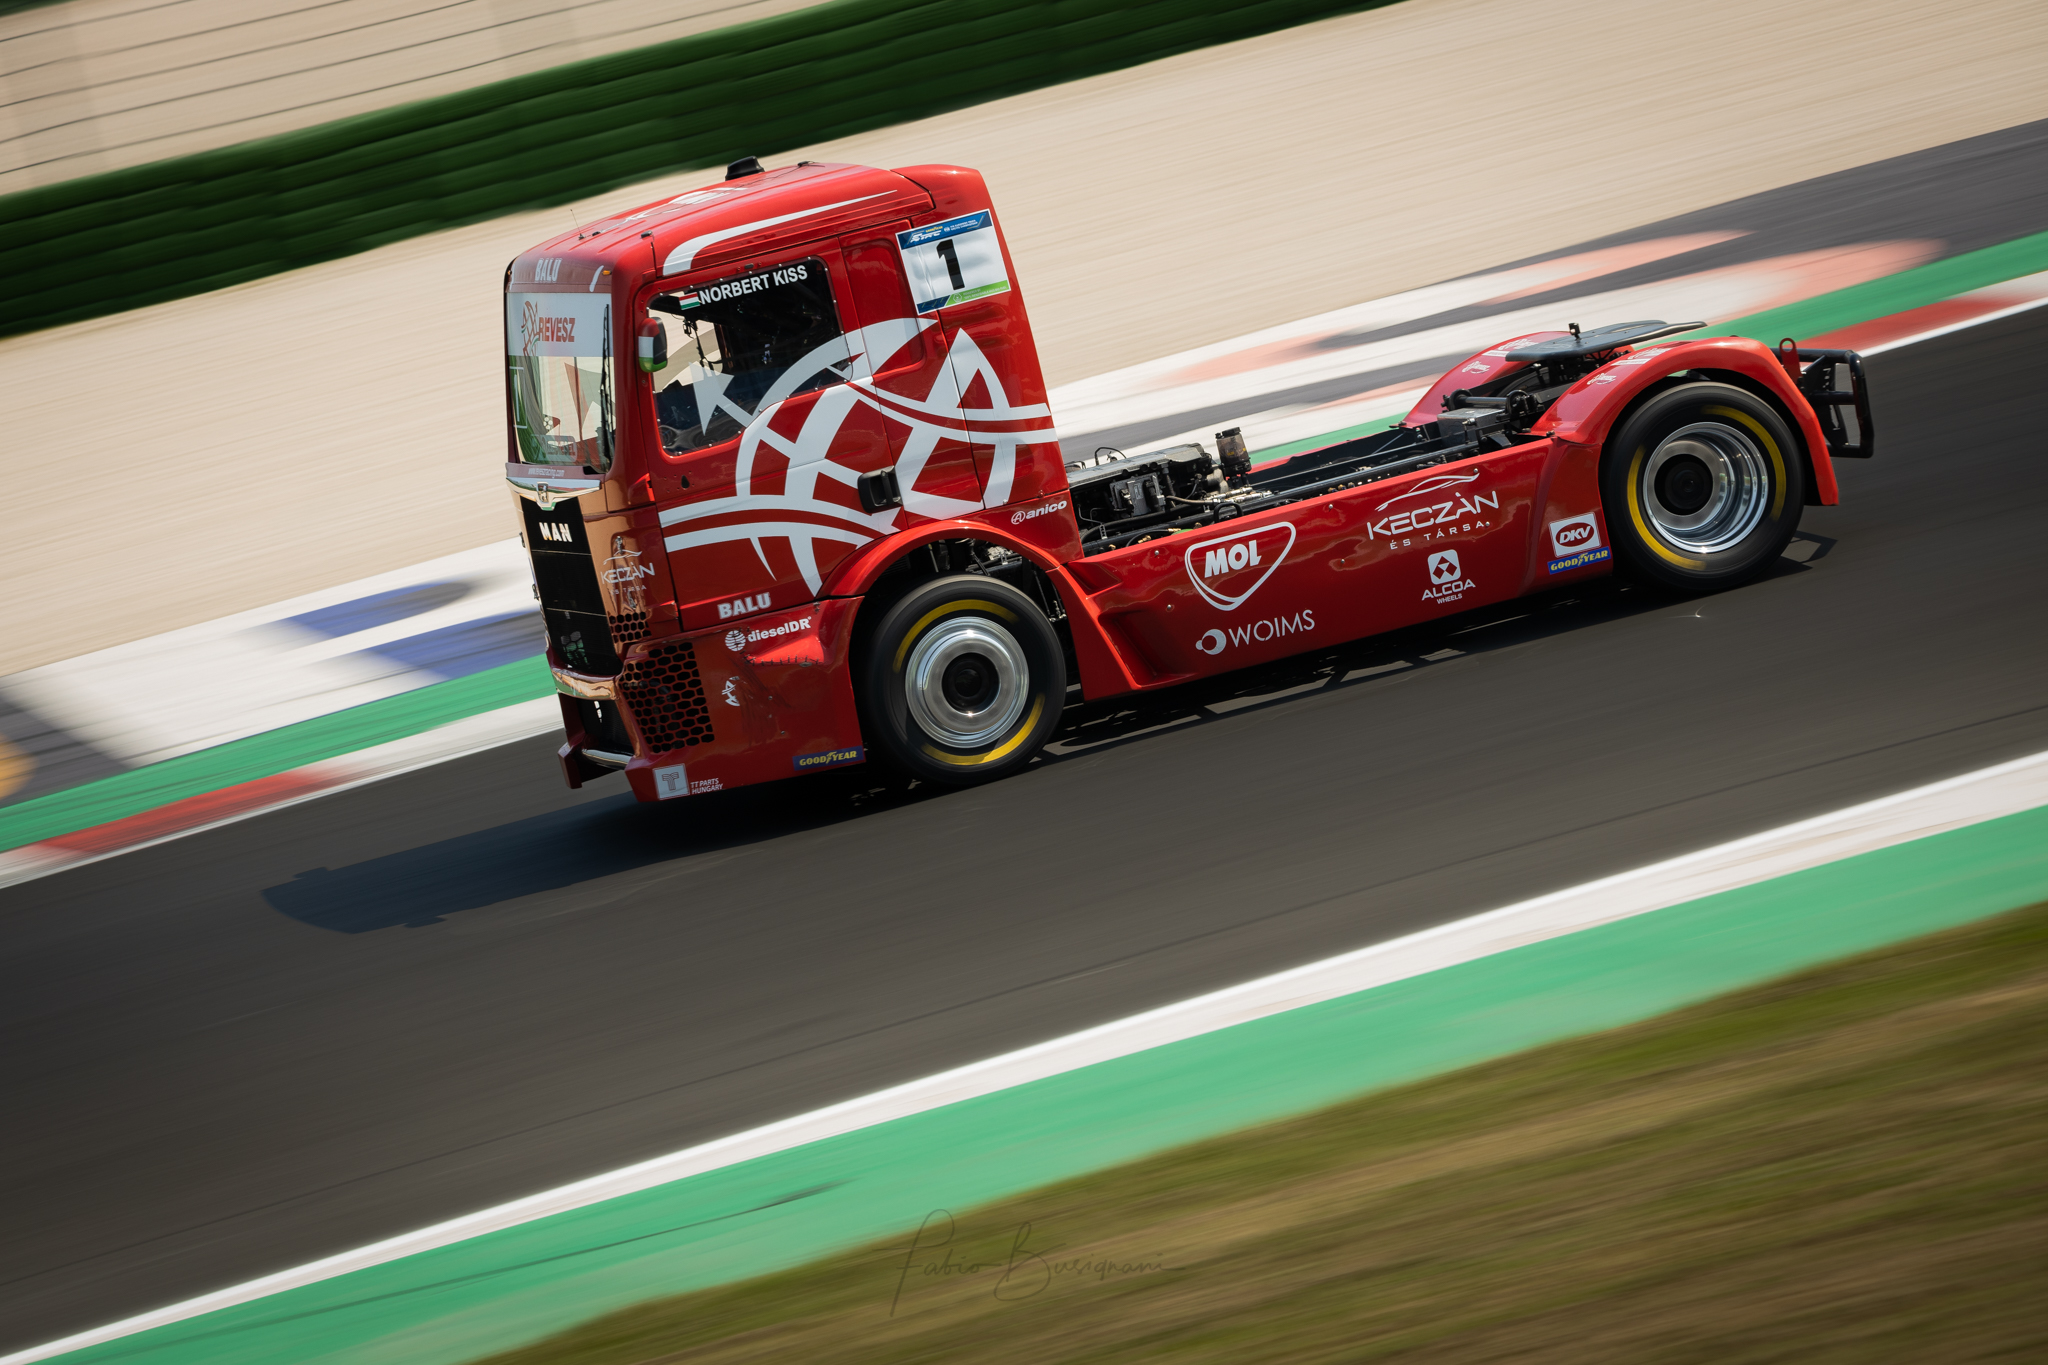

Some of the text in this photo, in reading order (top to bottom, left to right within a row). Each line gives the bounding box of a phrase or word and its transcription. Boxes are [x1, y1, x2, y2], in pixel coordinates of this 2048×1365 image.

[534, 257, 563, 283] BALU
[936, 238, 965, 291] 1
[699, 264, 808, 305] NORBERT KISS
[538, 521, 573, 543] MAN
[1559, 525, 1592, 544] DKV
[1389, 538, 1412, 550] ÉS
[1204, 539, 1262, 578] MOL
[1550, 550, 1609, 571] GOODYEAR
[1421, 578, 1476, 601] ALCOA
[1436, 593, 1463, 604] WHEELS
[717, 592, 772, 620] BALU
[1228, 609, 1315, 648] WOIMS
[799, 750, 857, 766] GOODYEAR
[691, 783, 723, 795] HUNGARY
[700, 778, 719, 787] PARTS
